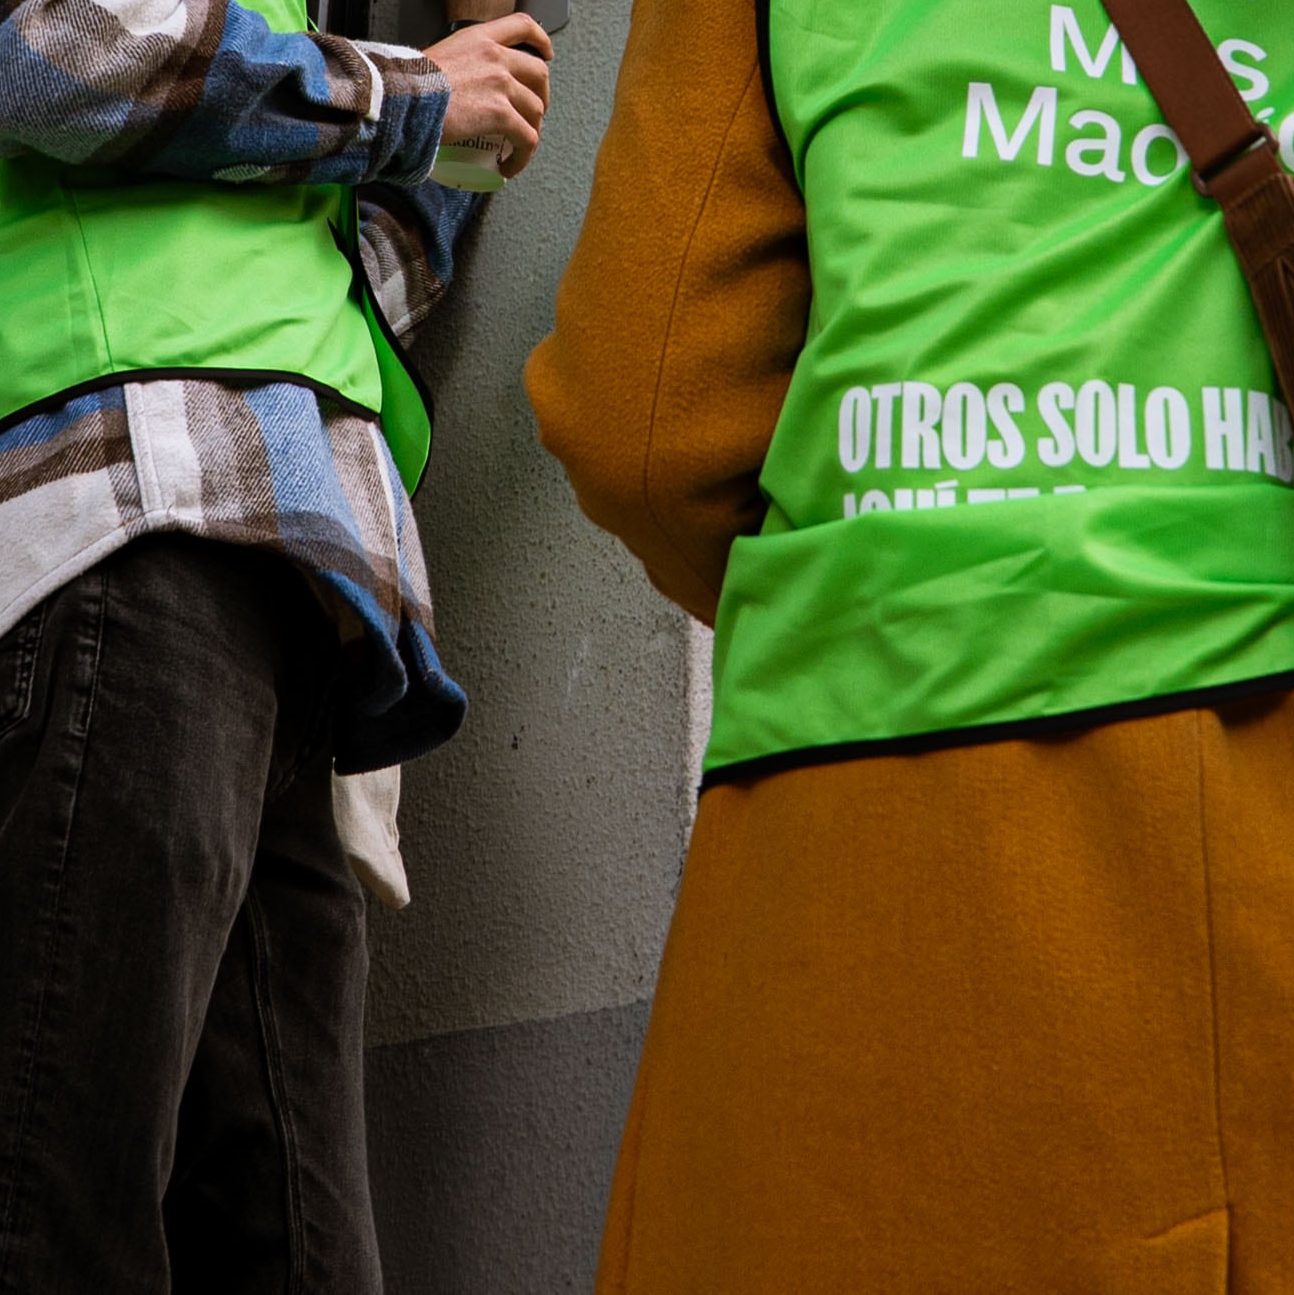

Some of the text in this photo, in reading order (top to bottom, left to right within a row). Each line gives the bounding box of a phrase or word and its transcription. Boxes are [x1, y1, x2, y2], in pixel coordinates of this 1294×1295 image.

[1049, 3, 1270, 103] Ms
[838, 381, 1026, 473] OTROS
[1037, 378, 1192, 470] SOLO
